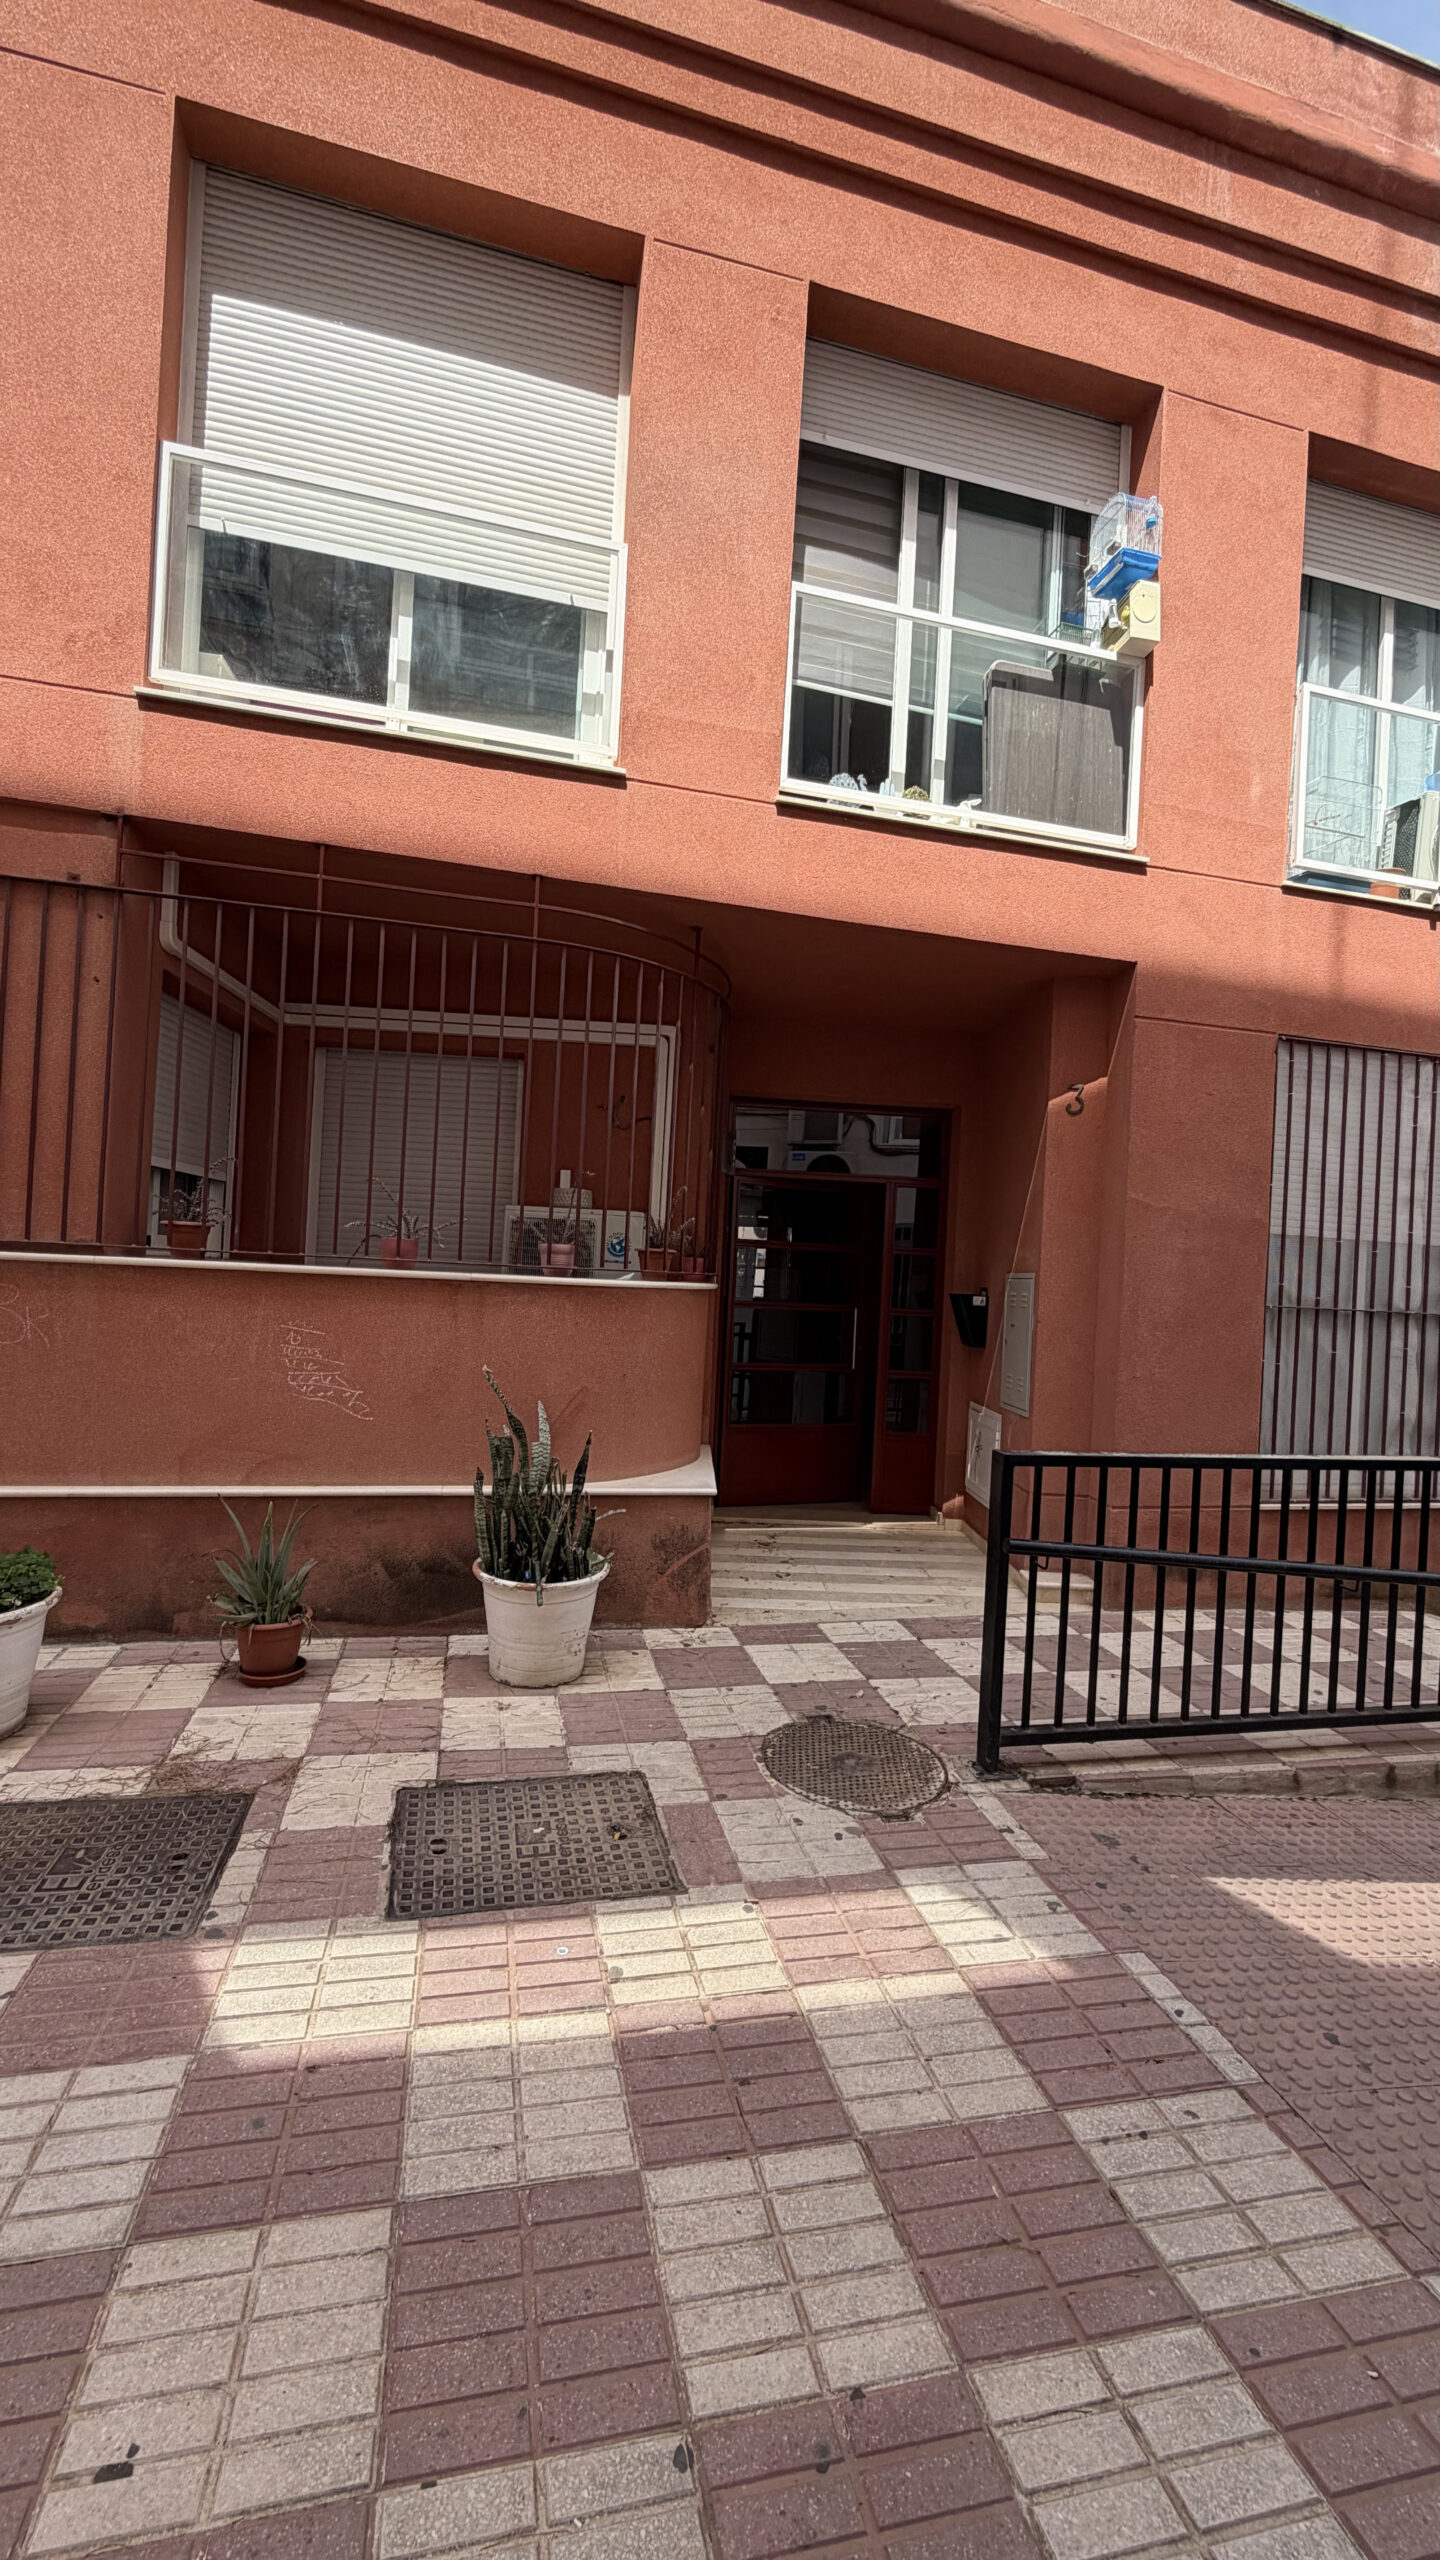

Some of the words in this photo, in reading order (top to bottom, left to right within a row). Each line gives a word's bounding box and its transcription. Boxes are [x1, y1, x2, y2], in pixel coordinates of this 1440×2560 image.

[1065, 1084, 1085, 1116] 3
[555, 1817, 572, 1858] endesa
[86, 1841, 126, 1891] endesa
